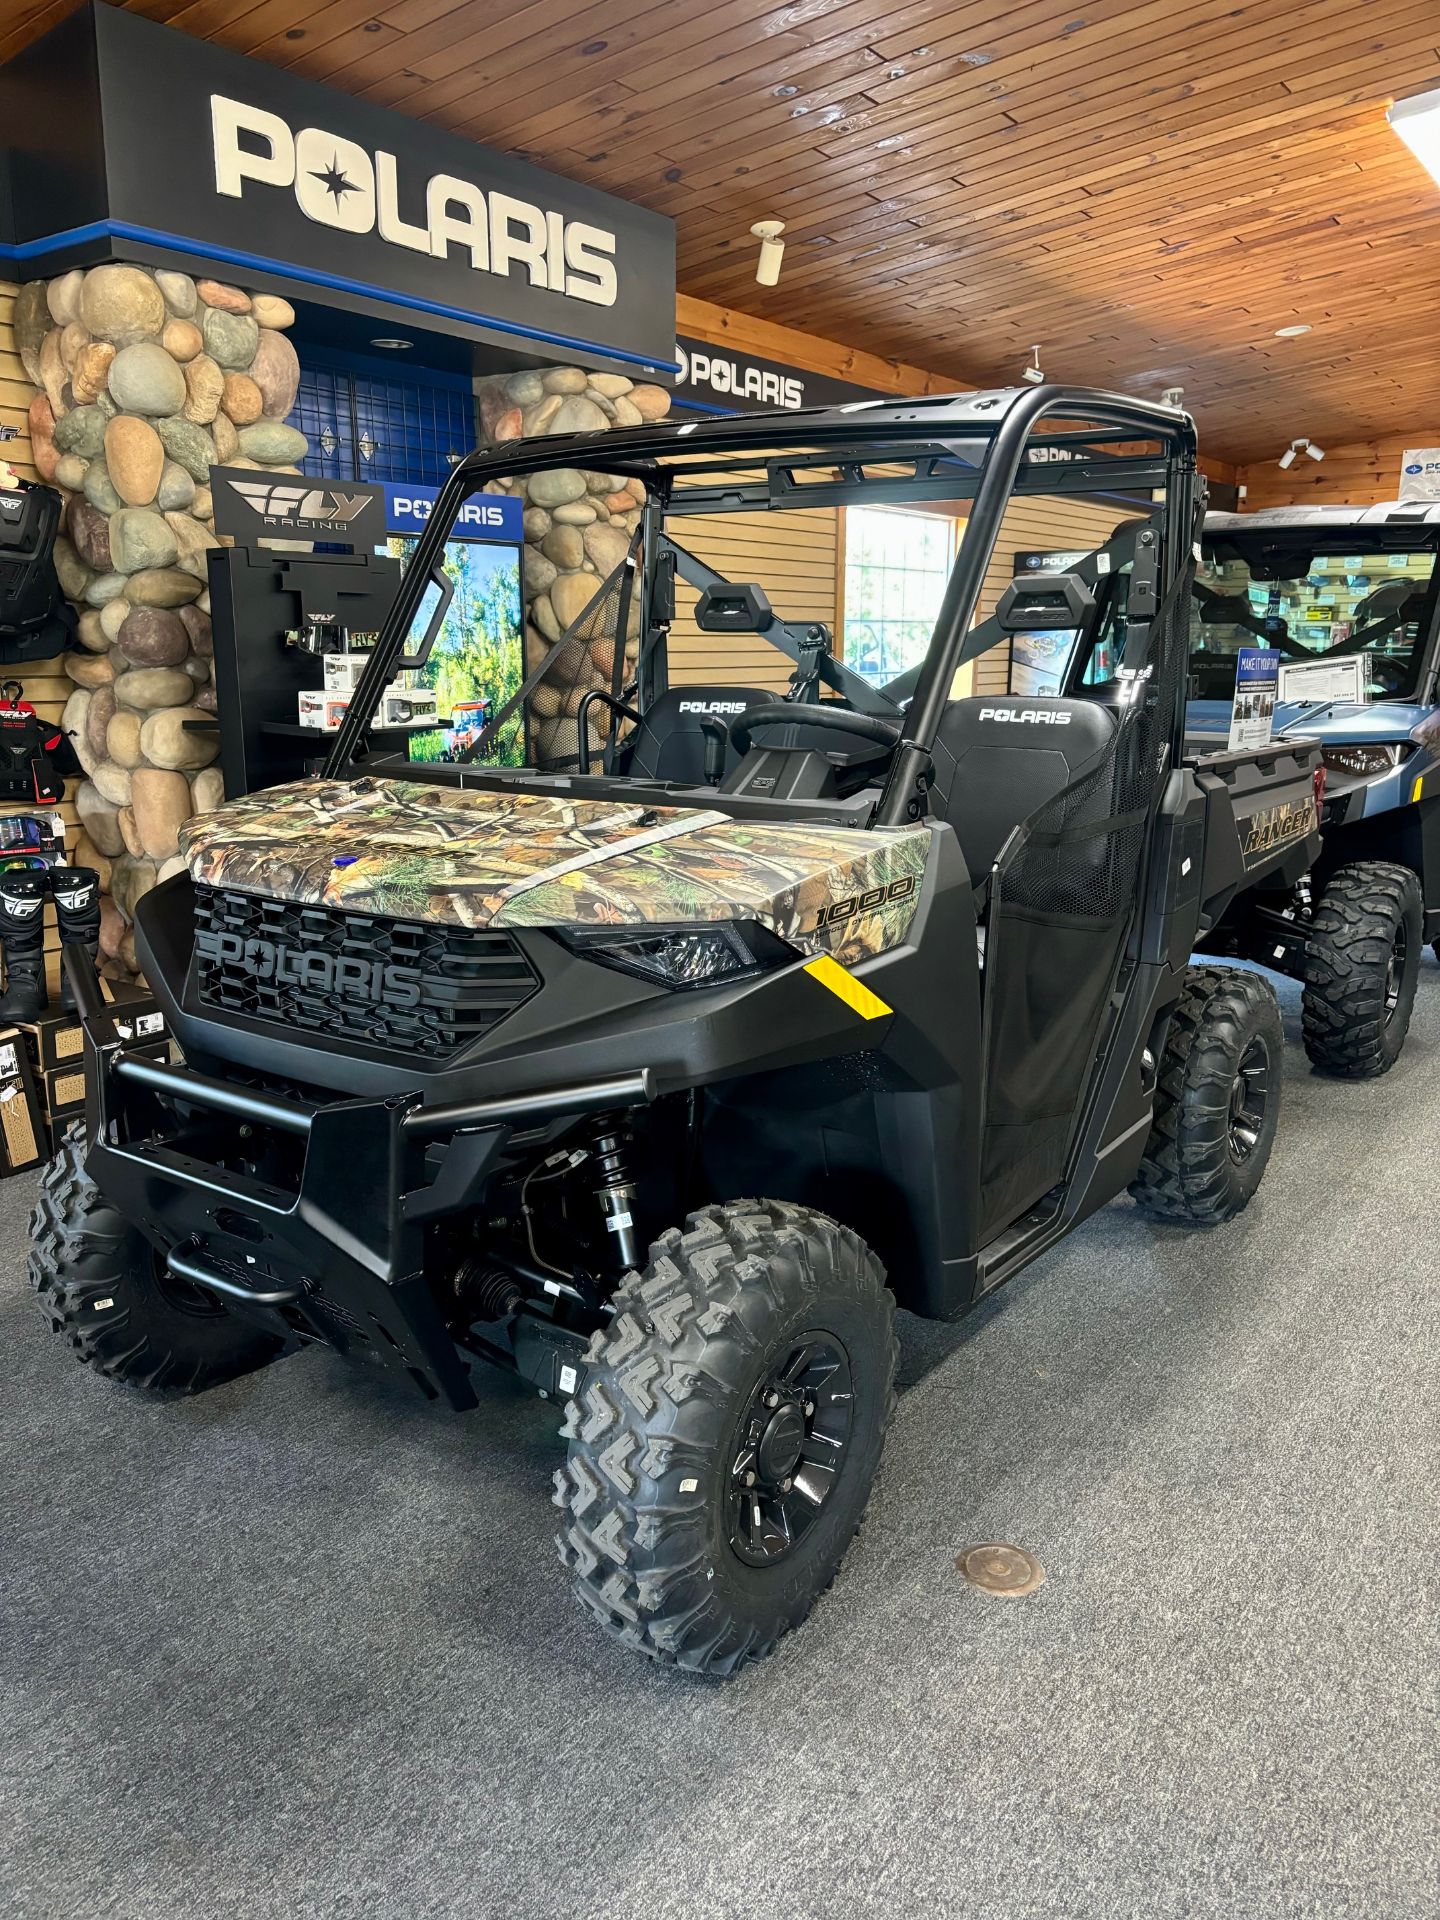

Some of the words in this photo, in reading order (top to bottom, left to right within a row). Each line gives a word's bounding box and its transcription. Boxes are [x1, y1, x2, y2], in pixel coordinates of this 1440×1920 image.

[211, 94, 617, 306] POLARIS
[691, 353, 801, 409] POLARIS
[252, 483, 373, 520] FLY
[393, 497, 504, 526] PORIS
[264, 516, 347, 531] RACING
[1042, 556, 1083, 567] POLAR
[355, 632, 369, 647] FLY
[1240, 657, 1255, 671] MAKE
[679, 702, 747, 713] POLARIS
[979, 708, 1072, 724] POLARIS
[1243, 806, 1312, 856] RANGER
[816, 875, 916, 930] 1000
[217, 931, 422, 1008] POLARIS
